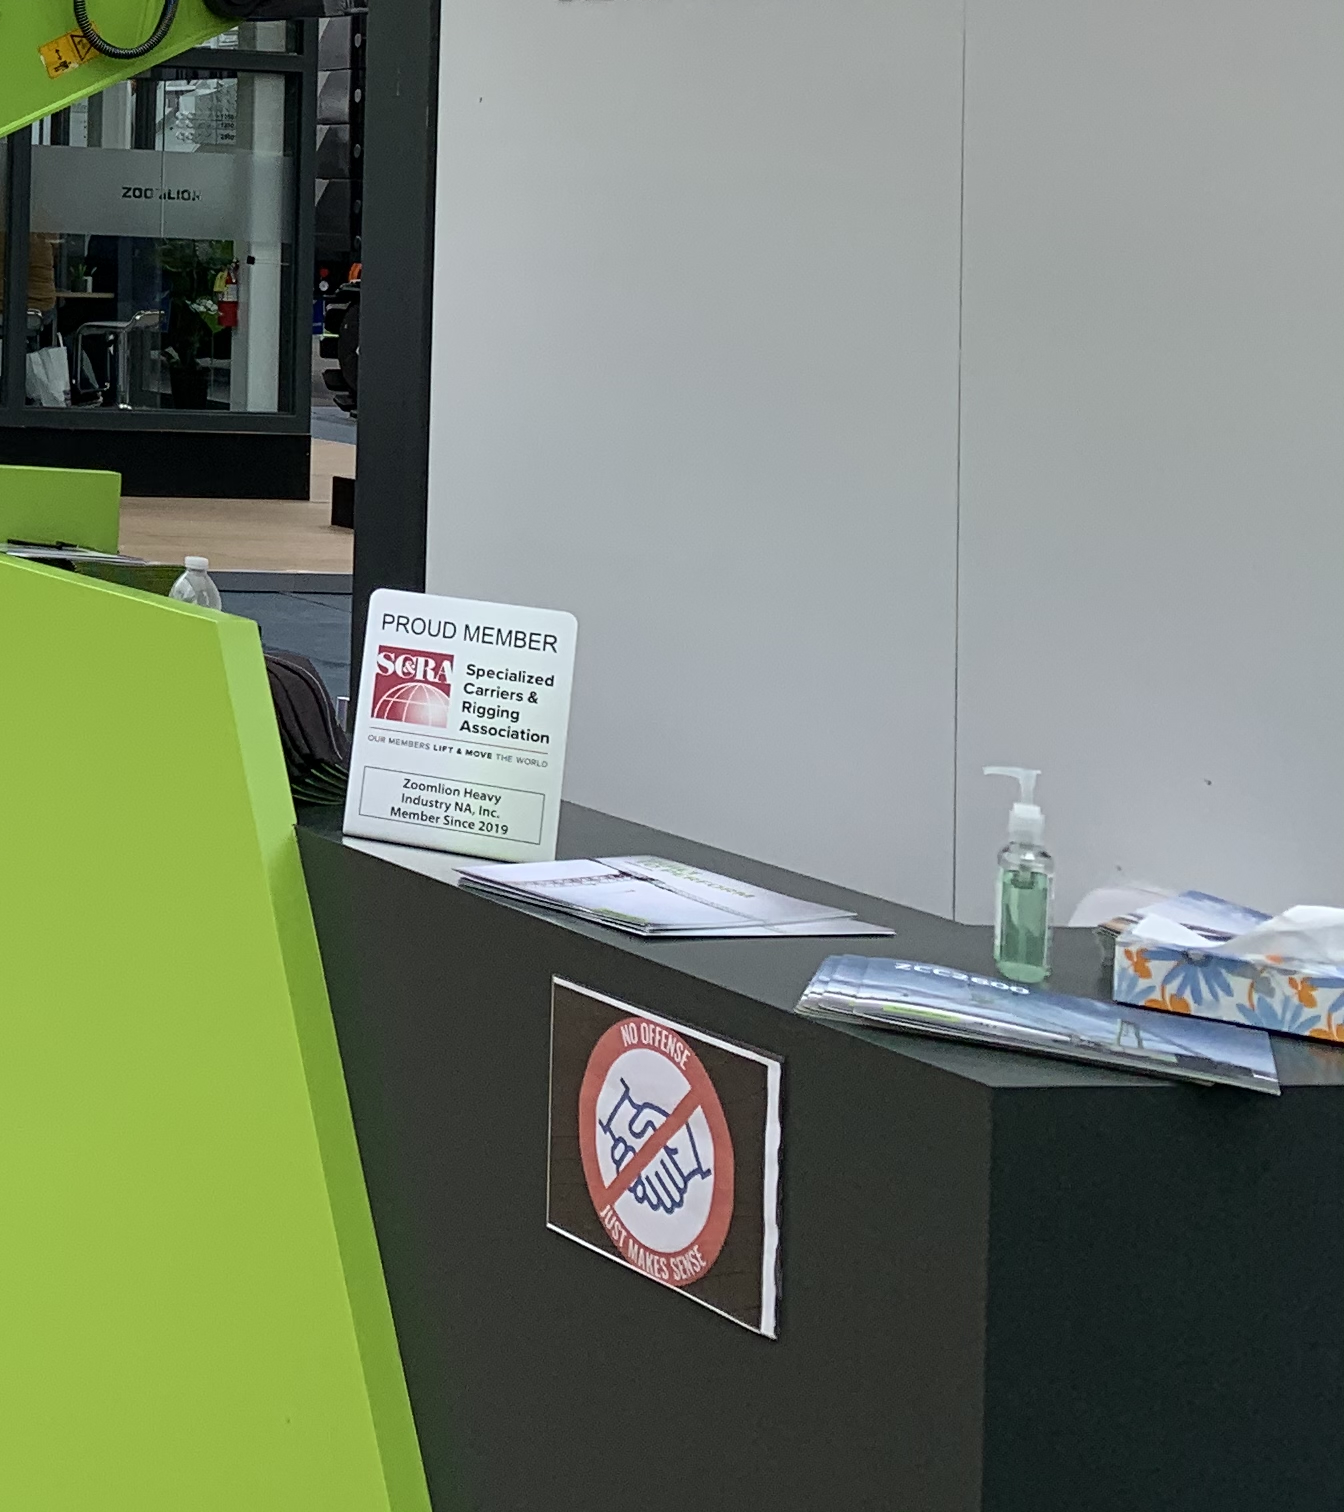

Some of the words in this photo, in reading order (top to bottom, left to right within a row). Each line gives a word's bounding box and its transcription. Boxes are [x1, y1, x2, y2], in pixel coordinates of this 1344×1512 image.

[382, 613, 457, 639] PROUD
[464, 624, 559, 654] MEMBER
[376, 651, 452, 684] SC&RA
[466, 664, 554, 687] Specialized
[463, 682, 524, 703] Carriers
[527, 692, 538, 704] &
[462, 701, 520, 723] Rigging
[459, 720, 550, 745] Association
[367, 734, 386, 745] OUR
[388, 736, 431, 750] MEMBERS
[433, 743, 453, 754] LIFT
[465, 748, 493, 760] MOVE
[496, 753, 513, 763] THE
[516, 756, 549, 768] WORLD
[402, 778, 460, 797] Zoomlion
[463, 787, 502, 805] Heavy
[401, 793, 451, 813] Industry
[454, 801, 476, 815] NA,
[478, 805, 500, 819] Inc.
[390, 806, 440, 825] Member
[443, 814, 475, 831] Since
[478, 820, 509, 835] 2019
[620, 1022, 639, 1048] NO
[641, 1022, 691, 1071] OFFENSE
[600, 1204, 628, 1241] JUST
[628, 1234, 669, 1281] MAKES
[670, 1244, 706, 1282] SENSE
